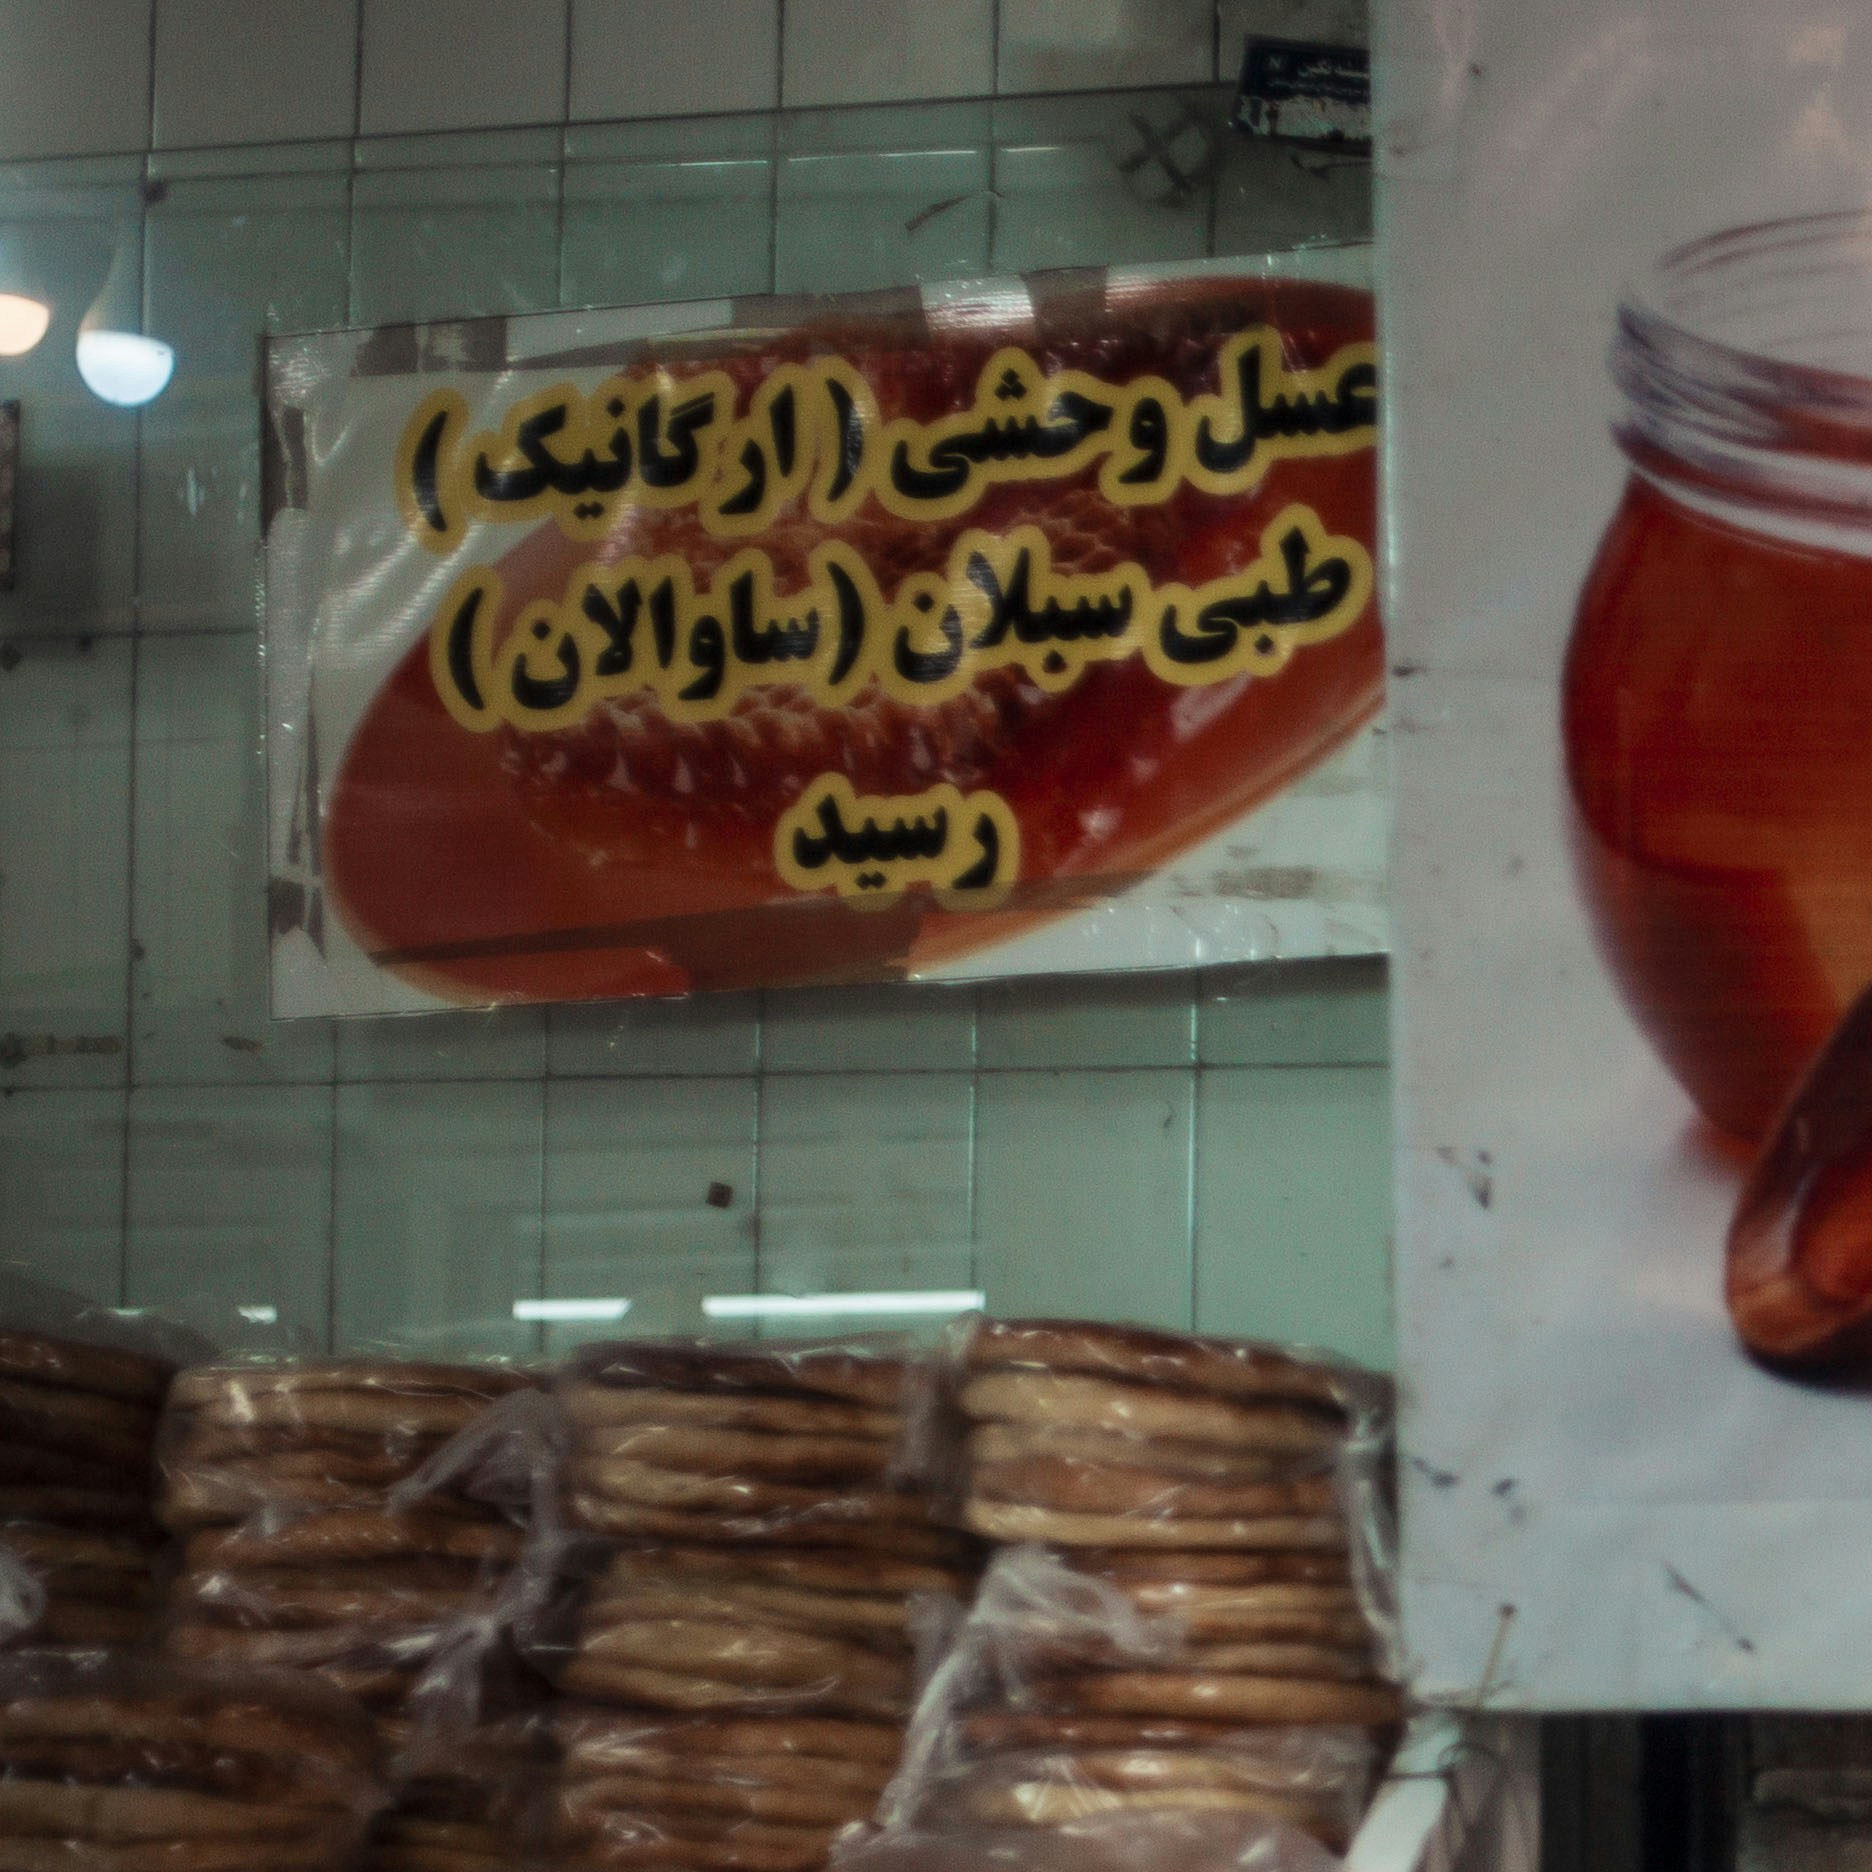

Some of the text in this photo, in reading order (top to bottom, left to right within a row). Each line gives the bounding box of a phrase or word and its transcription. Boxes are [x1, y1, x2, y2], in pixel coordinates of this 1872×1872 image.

[890, 367, 1168, 499] وحشی
[1196, 344, 1376, 473] عسل
[894, 548, 1133, 684] سبلان
[1159, 526, 1352, 664] طبی
[792, 793, 1000, 890] رسید
